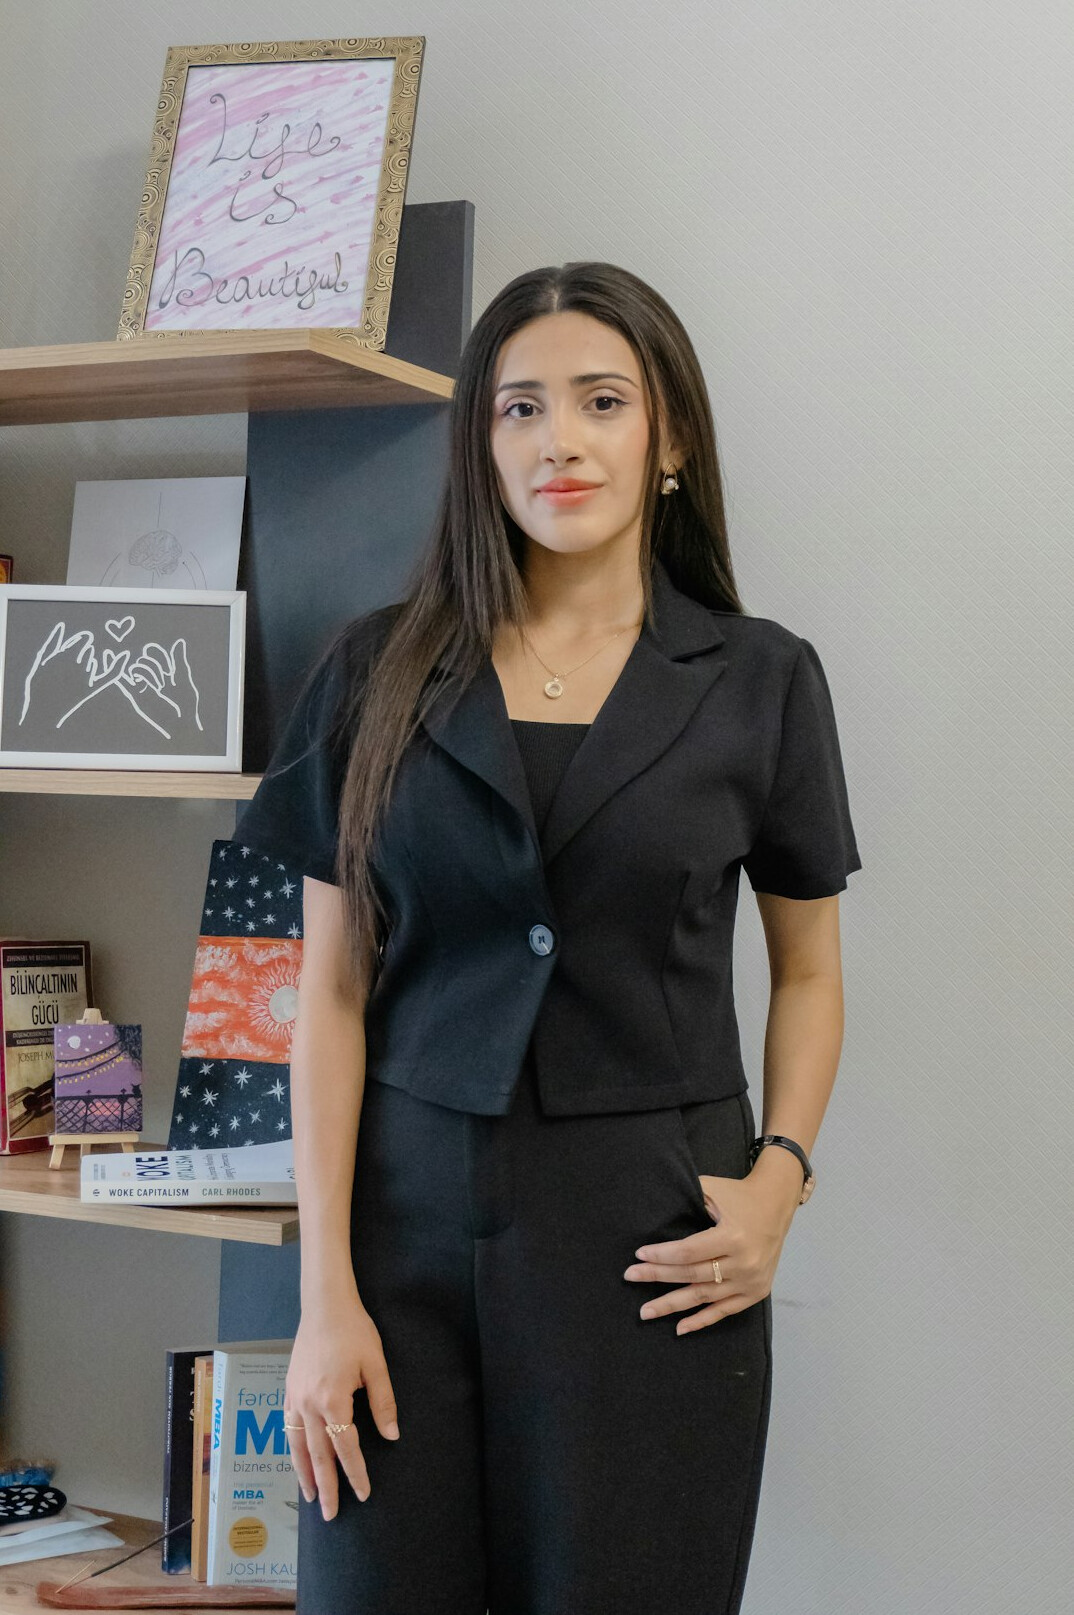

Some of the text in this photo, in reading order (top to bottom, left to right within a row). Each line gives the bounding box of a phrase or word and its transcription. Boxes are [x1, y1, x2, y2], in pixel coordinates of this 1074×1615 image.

[207, 93, 341, 180] Life
[229, 170, 298, 225] is
[158, 247, 349, 310] Beautiful
[10, 970, 78, 999] BİLİNÇALTININ
[31, 1000, 59, 1025] GÜCÜ
[18, 1051, 55, 1064] JOSEPH M
[108, 1187, 261, 1197] WOKE CAPITALISM CARL RHODES
[213, 1398, 223, 1450] MBA
[234, 1409, 291, 1455] M
[233, 1460, 272, 1473] biznes
[233, 1489, 264, 1499] MBA
[226, 1562, 266, 1576] JOSH
